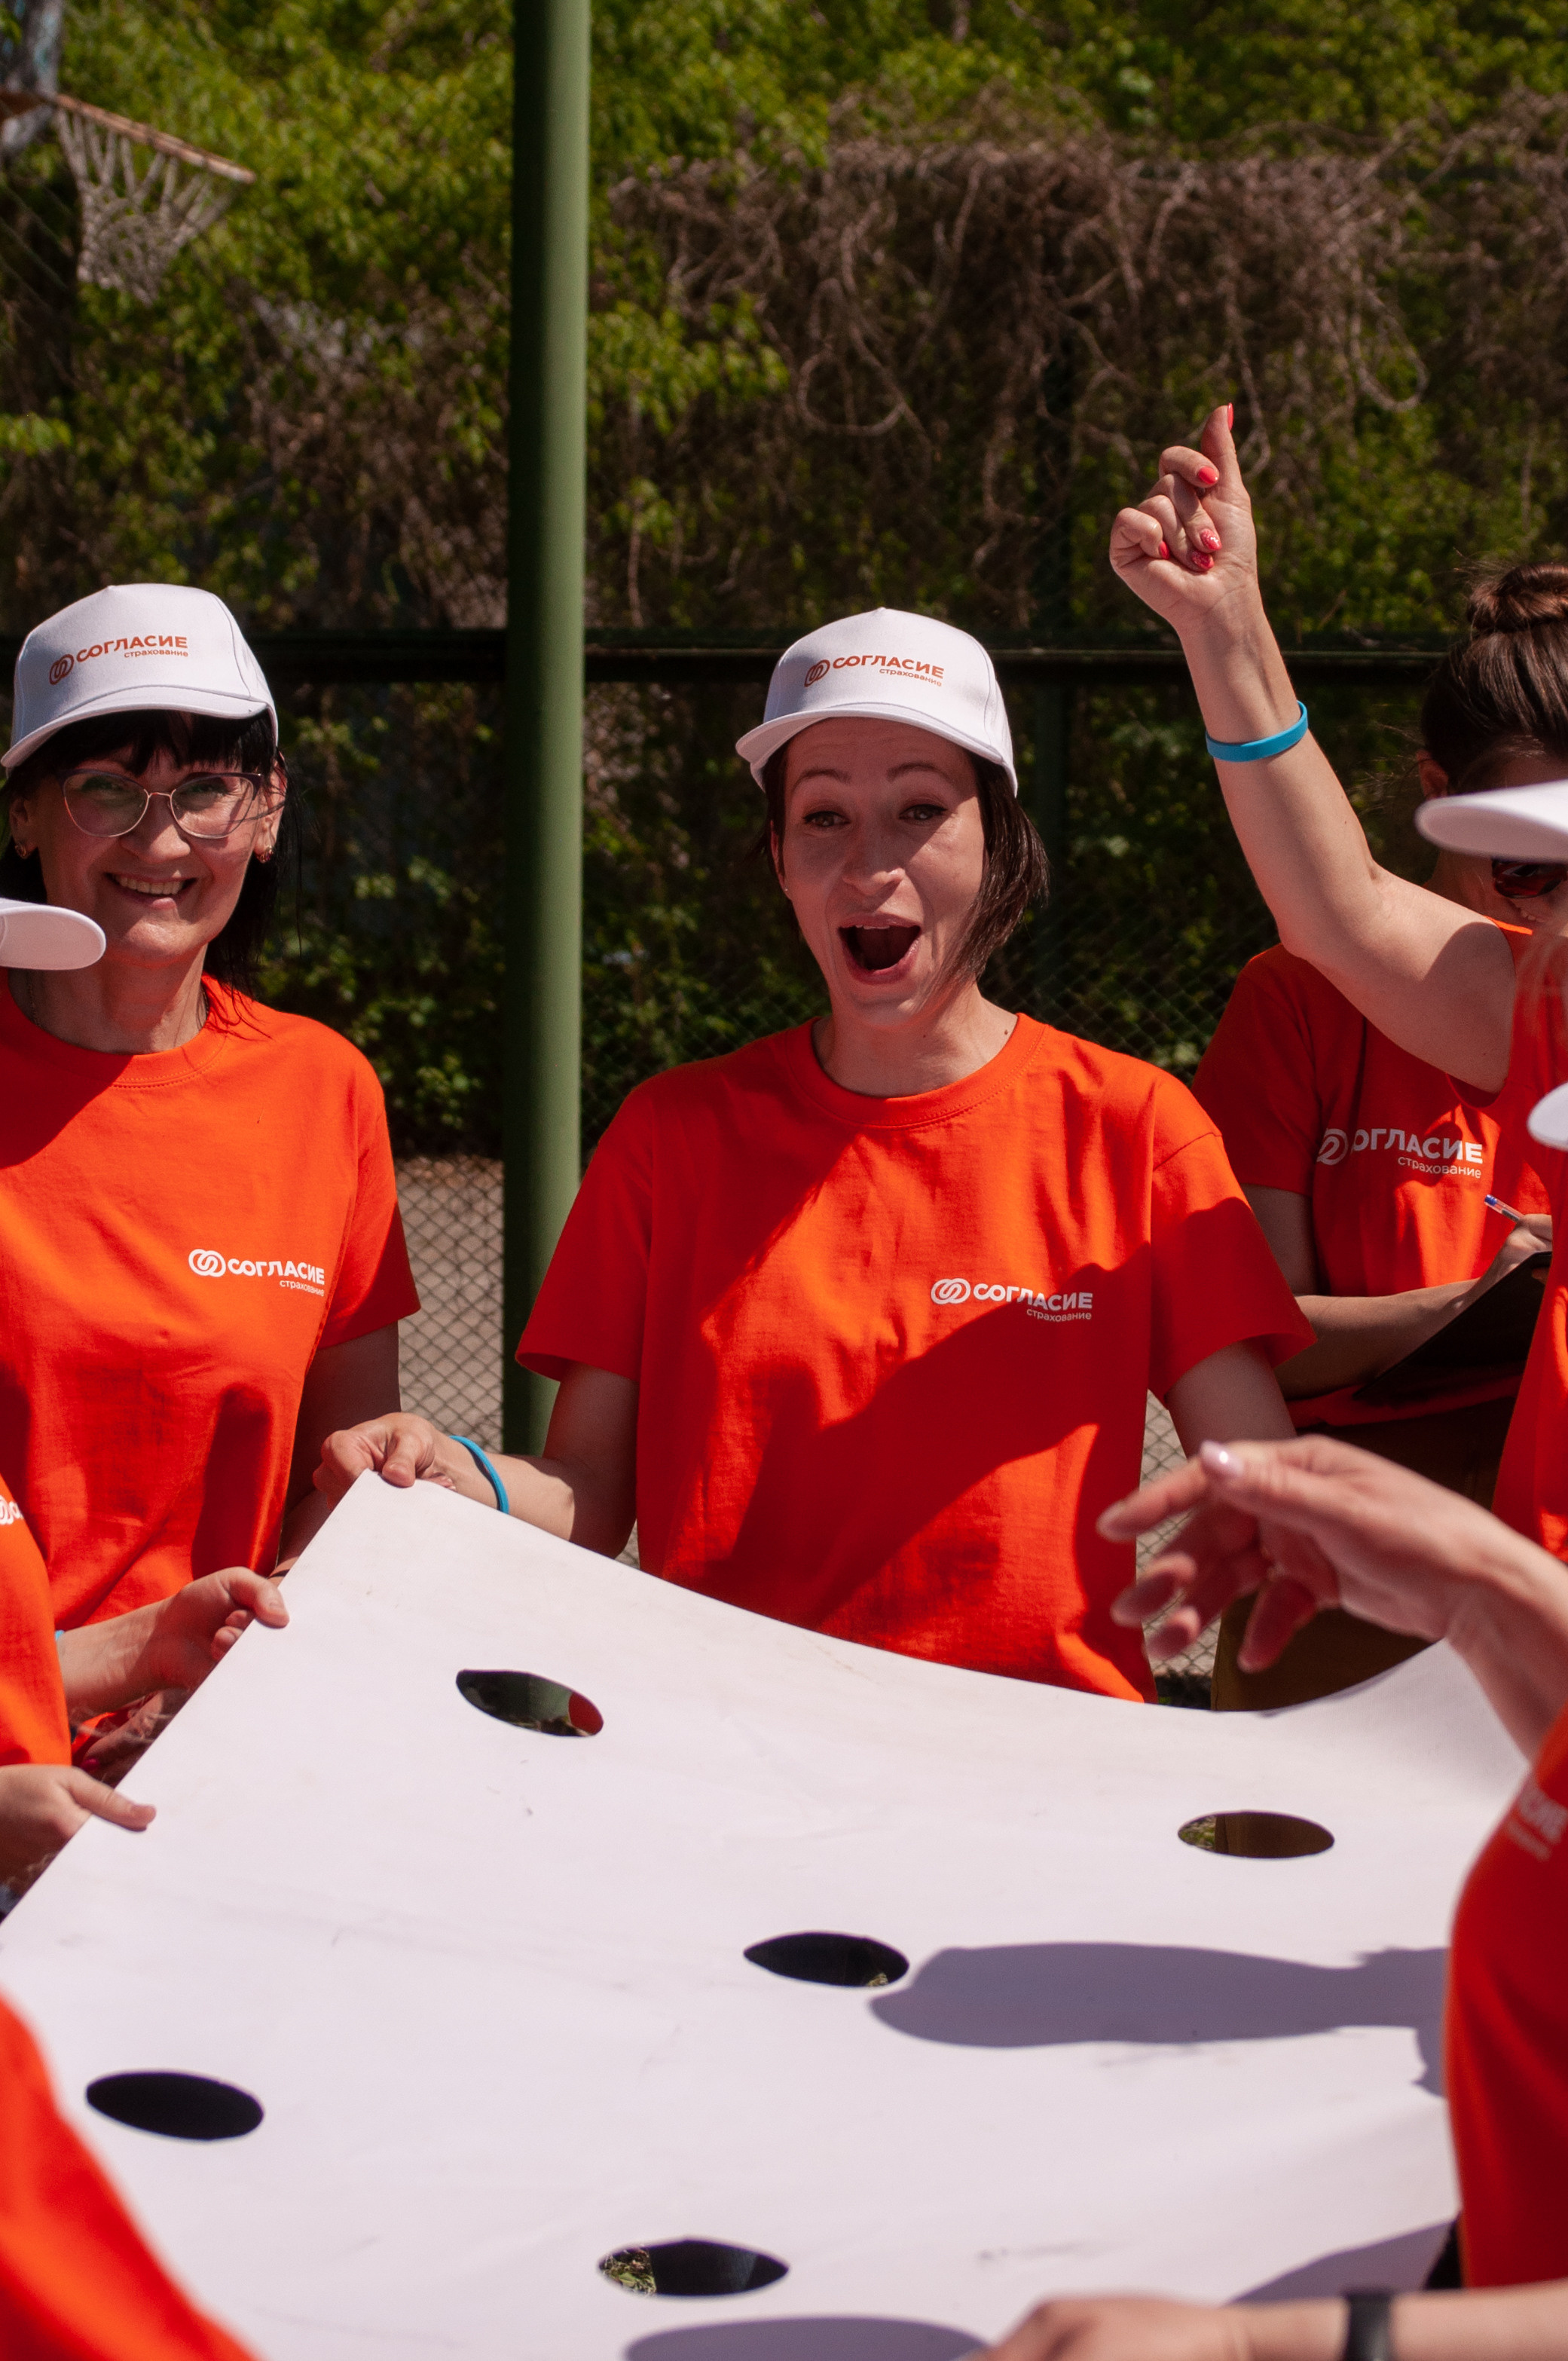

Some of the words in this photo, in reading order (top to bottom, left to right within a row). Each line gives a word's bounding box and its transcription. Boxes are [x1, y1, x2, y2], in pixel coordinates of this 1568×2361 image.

[76, 635, 188, 662] СОГЛАСИЕ
[124, 649, 188, 658] страхование
[833, 655, 944, 679] СОГЛАСИЕ
[879, 668, 942, 687] страхование
[1351, 1128, 1483, 1164] ОГЛАСИЕ
[1398, 1157, 1481, 1179] страхование
[228, 1258, 326, 1286] СОГЛАСИЕ
[280, 1280, 325, 1297] страхование
[973, 1283, 1093, 1311] СОГЛАСИЕ
[1026, 1308, 1092, 1323] страхование
